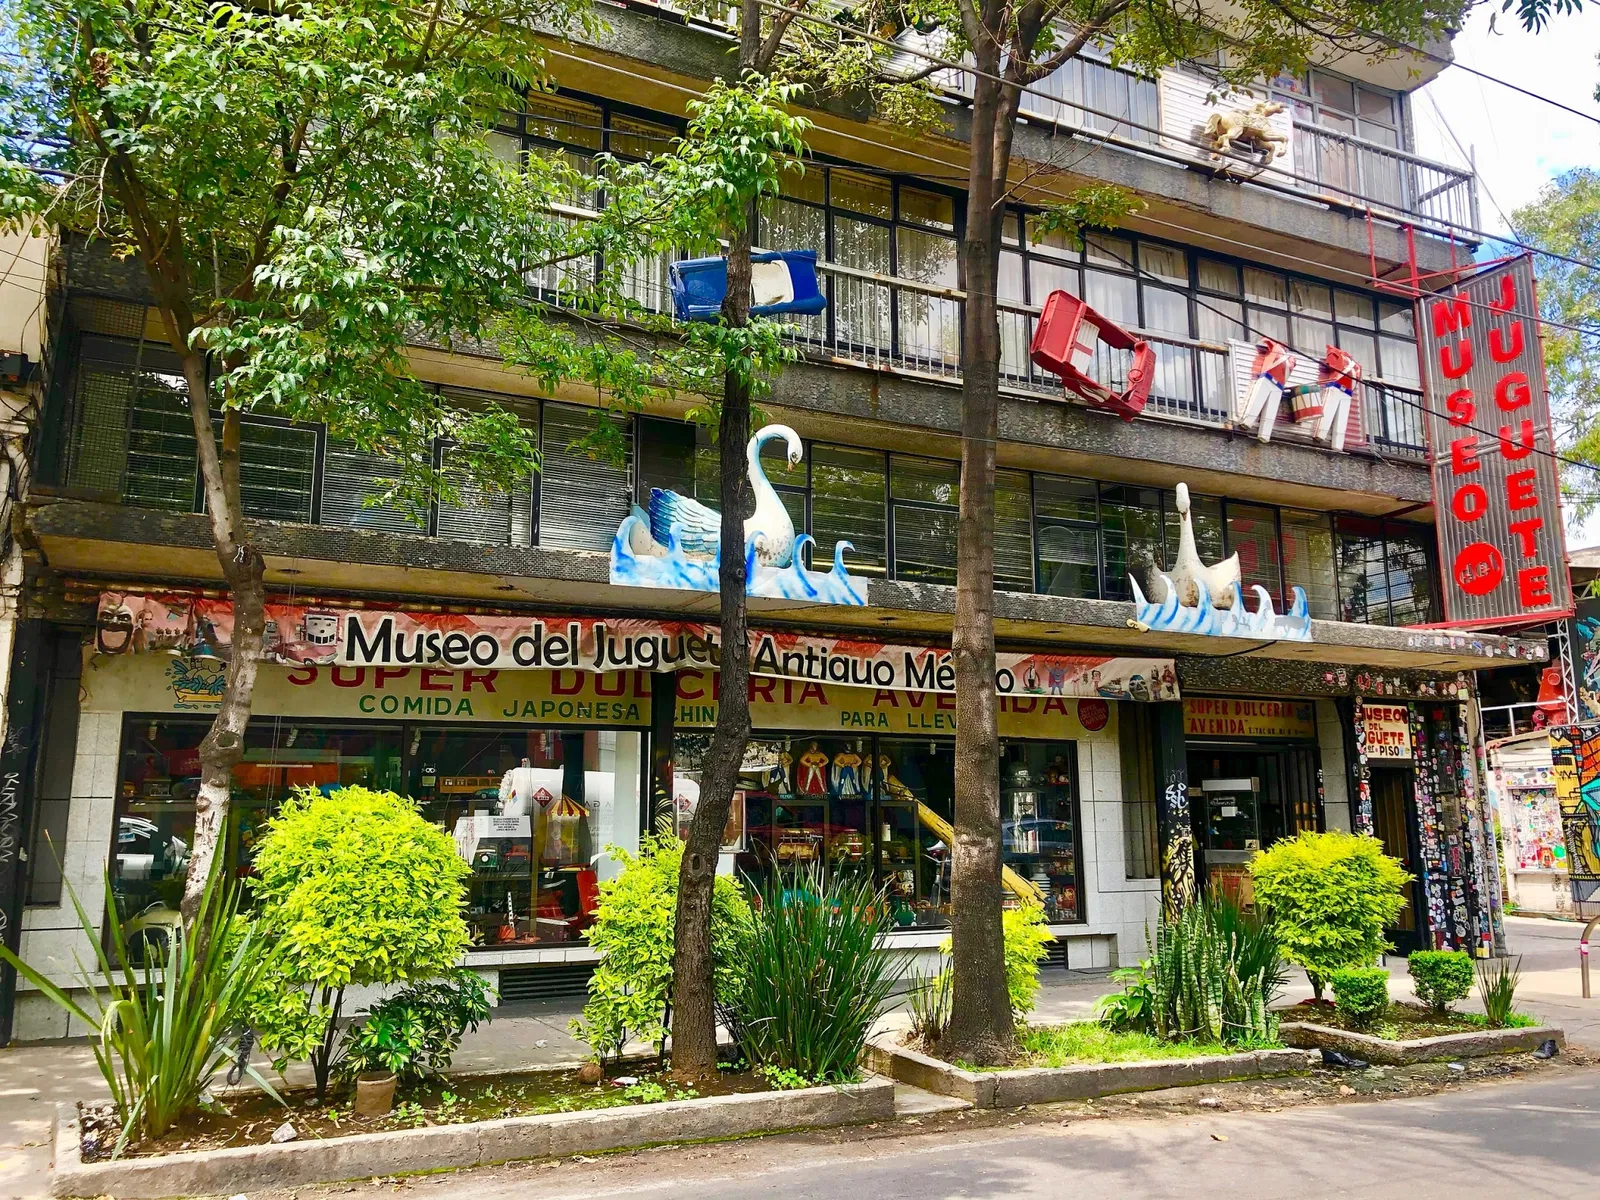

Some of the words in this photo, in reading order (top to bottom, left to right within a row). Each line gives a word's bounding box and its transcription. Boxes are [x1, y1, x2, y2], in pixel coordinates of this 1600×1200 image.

[1432, 291, 1488, 522] MUSEO
[1488, 273, 1552, 607] JUGUETE
[345, 616, 497, 666] Museo
[512, 623, 578, 666] del
[593, 625, 720, 670] Juguet
[905, 652, 1014, 693] Méo
[359, 694, 473, 717] COMIDA
[503, 700, 640, 721] JAPONESA
[841, 711, 888, 728] PARA
[872, 689, 1068, 716] AVEIDA
[1235, 701, 1293, 718] DULCERIA
[1369, 723, 1383, 731] DEL
[1379, 745, 1400, 756] PISO
